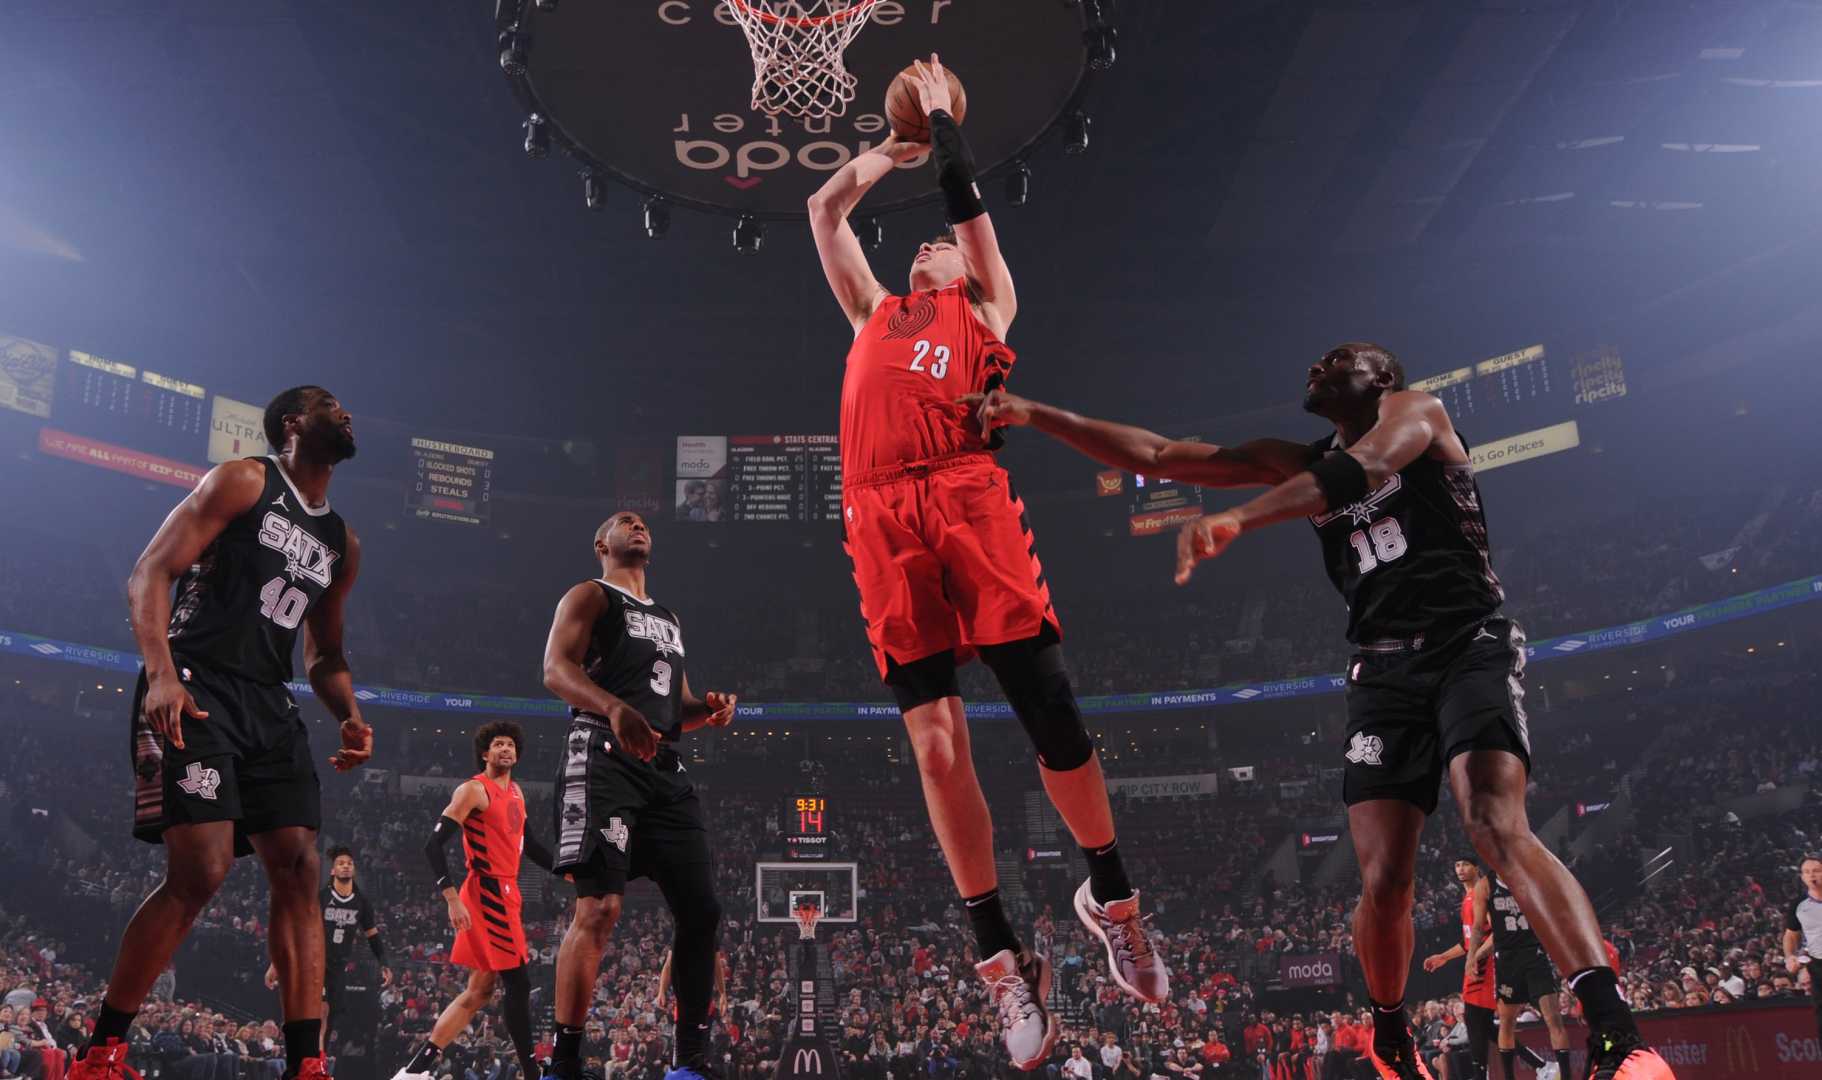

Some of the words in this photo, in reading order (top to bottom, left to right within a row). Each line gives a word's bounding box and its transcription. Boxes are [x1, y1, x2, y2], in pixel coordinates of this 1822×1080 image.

[673, 113, 886, 136] enter
[909, 339, 950, 380] 23
[1575, 382, 1627, 404] ripcity
[212, 419, 266, 443] ULTRA
[784, 435, 806, 444] STATS
[807, 435, 838, 444] CENTRAL
[1487, 449, 1504, 462] Go
[1507, 438, 1545, 456] Places
[431, 485, 469, 498] STEALS
[259, 511, 341, 589] SATX
[1350, 516, 1408, 575] 18
[260, 576, 309, 630] 40
[1663, 613, 1695, 629] YOUR
[1588, 624, 1648, 643] RIVERSIDE
[65, 646, 120, 664] RIVERSIDE
[650, 660, 672, 697] 3
[1263, 679, 1315, 692] RIVERSIDE
[380, 691, 431, 704] RIVERSIDE
[444, 697, 472, 708] YOUR
[1151, 696, 1162, 705] IN
[1164, 692, 1216, 705] PAYMENTS
[737, 707, 763, 716] YOUR
[858, 707, 868, 716] IN
[1140, 783, 1168, 795] CITY
[1172, 781, 1200, 793] ROW
[796, 799, 824, 811] 9:31
[801, 811, 822, 833] 14
[1288, 960, 1333, 979] moda
